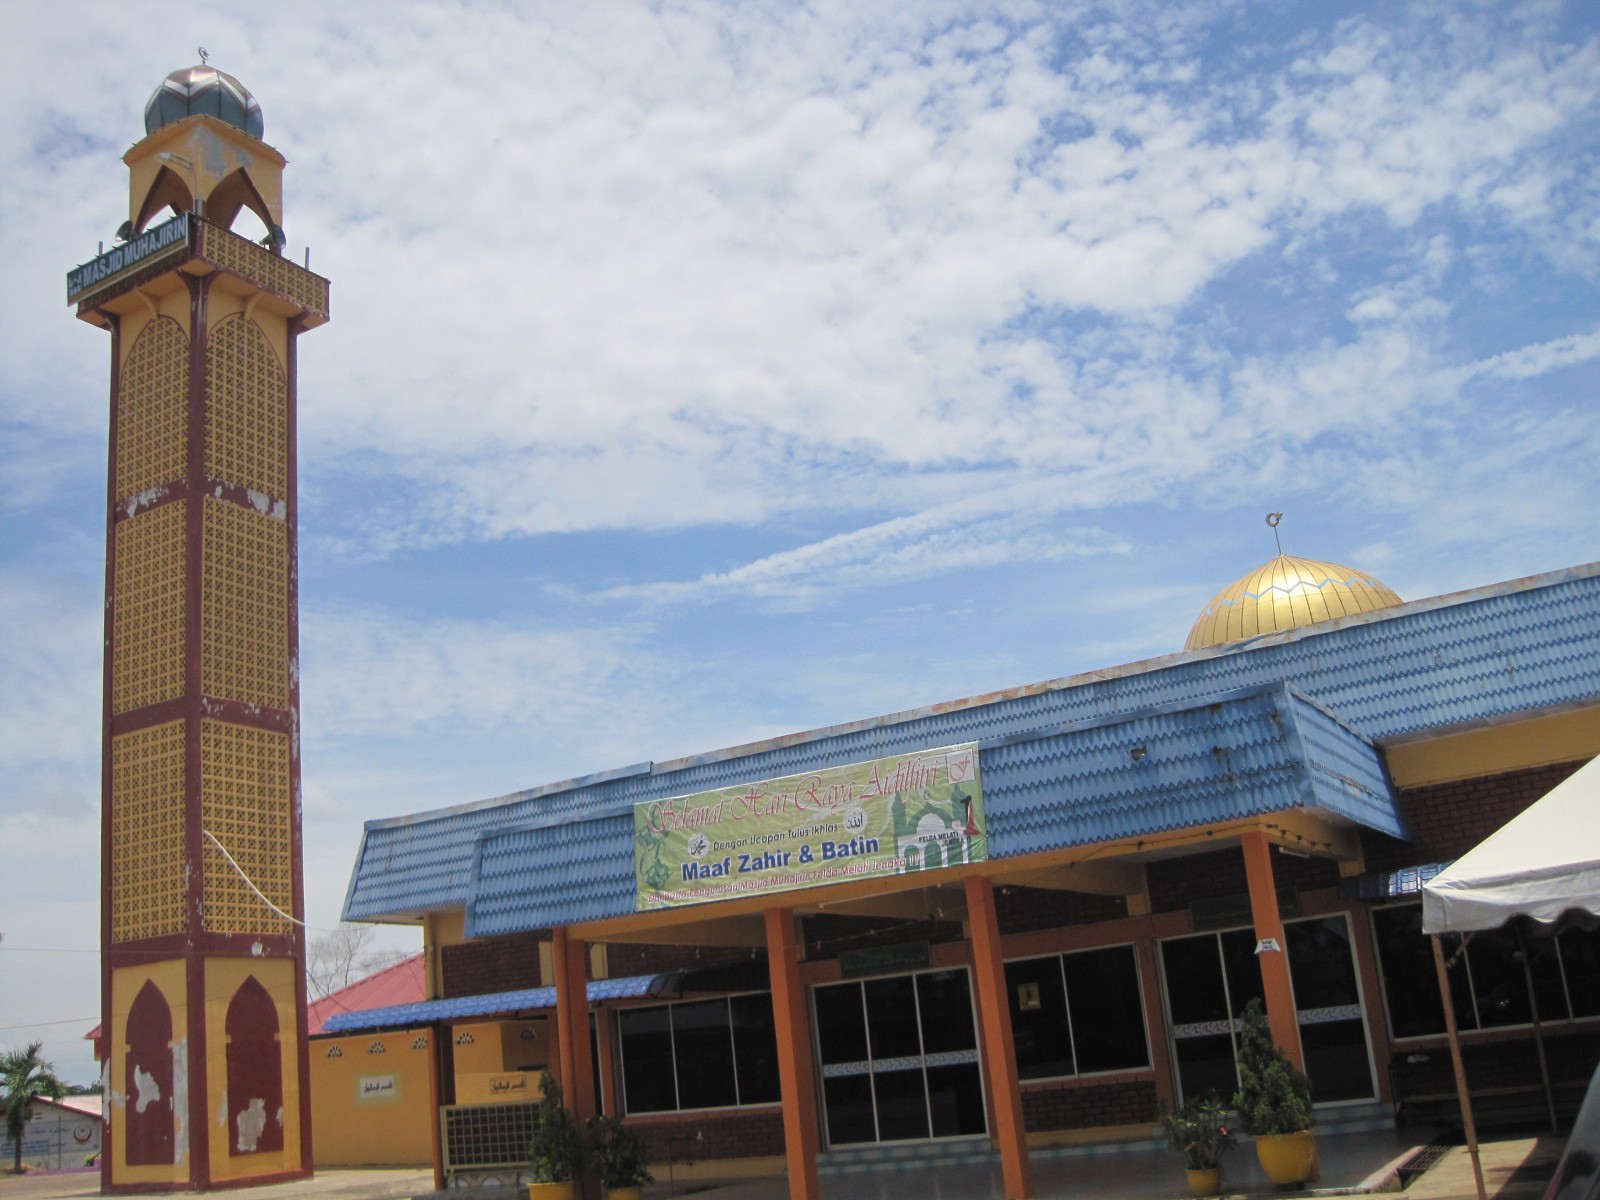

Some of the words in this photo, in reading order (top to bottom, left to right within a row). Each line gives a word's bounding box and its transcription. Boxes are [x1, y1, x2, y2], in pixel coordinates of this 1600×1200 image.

[83, 249, 123, 288] MASJID
[124, 216, 186, 266] MUHAJIRIN
[648, 799, 724, 833] Selamat
[730, 781, 789, 819] Hari
[795, 775, 856, 815] Raya
[859, 756, 938, 804] Aidilfitri
[682, 857, 731, 881] Maaf
[737, 849, 792, 874] Zahir
[798, 844, 815, 864] &
[821, 836, 879, 861] Batin
[713, 838, 748, 850] Dengan
[750, 832, 785, 845] Ucapan
[787, 828, 809, 838] Tulus
[811, 823, 838, 835] Ikhlas
[689, 883, 738, 898] Pengurusan
[740, 879, 768, 891] Masjid
[813, 867, 838, 879] Felda
[841, 863, 870, 876] Melati
[871, 857, 906, 873] Jengka
